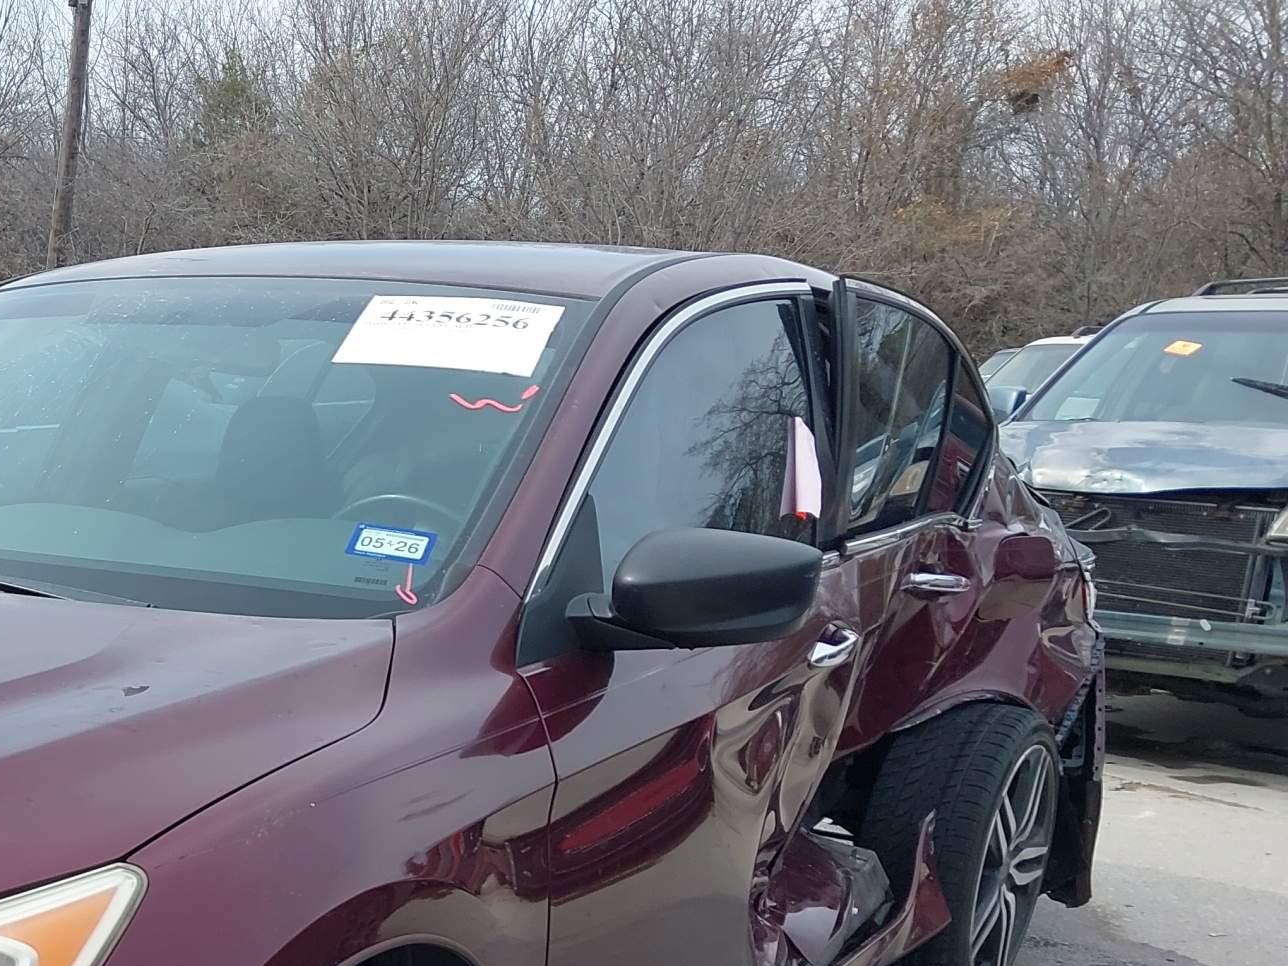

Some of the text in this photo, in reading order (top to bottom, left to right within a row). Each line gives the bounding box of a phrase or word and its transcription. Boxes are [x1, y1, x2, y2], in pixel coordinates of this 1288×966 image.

[379, 309, 530, 331] 44356256
[360, 535, 385, 549] 05
[394, 540, 420, 554] 26
